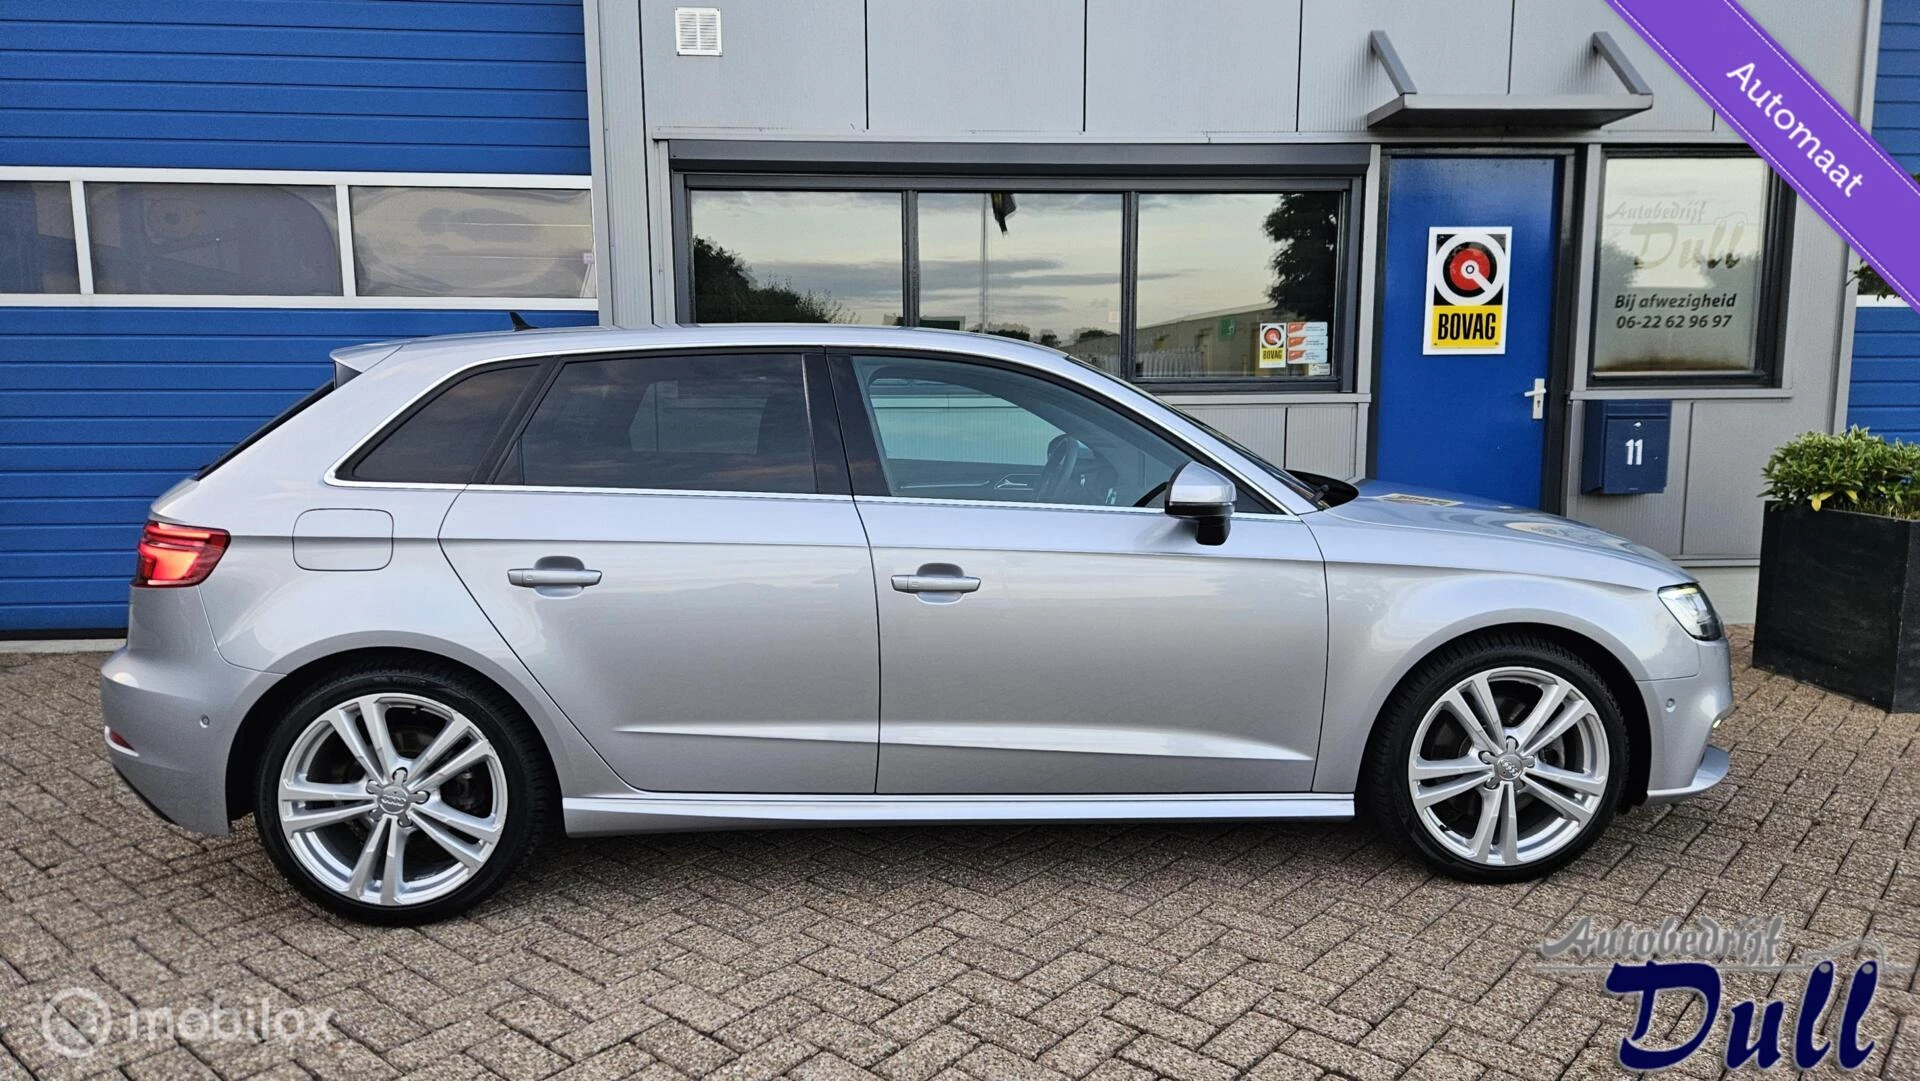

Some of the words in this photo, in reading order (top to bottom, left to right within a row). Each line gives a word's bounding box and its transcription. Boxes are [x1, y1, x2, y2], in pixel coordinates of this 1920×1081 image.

[1607, 201, 1707, 224] Autobedrijf
[1631, 222, 1744, 269] Dull
[1615, 294, 1636, 311] Bij
[1639, 293, 1737, 311] afwezigheid
[1438, 313, 1496, 340] BOVAG
[1616, 315, 1662, 329] 06-22
[1666, 315, 1685, 328] 62
[1689, 315, 1708, 328] 96
[1712, 315, 1732, 328] 97
[1263, 350, 1282, 360] BOVAG
[1625, 439, 1643, 465] 11
